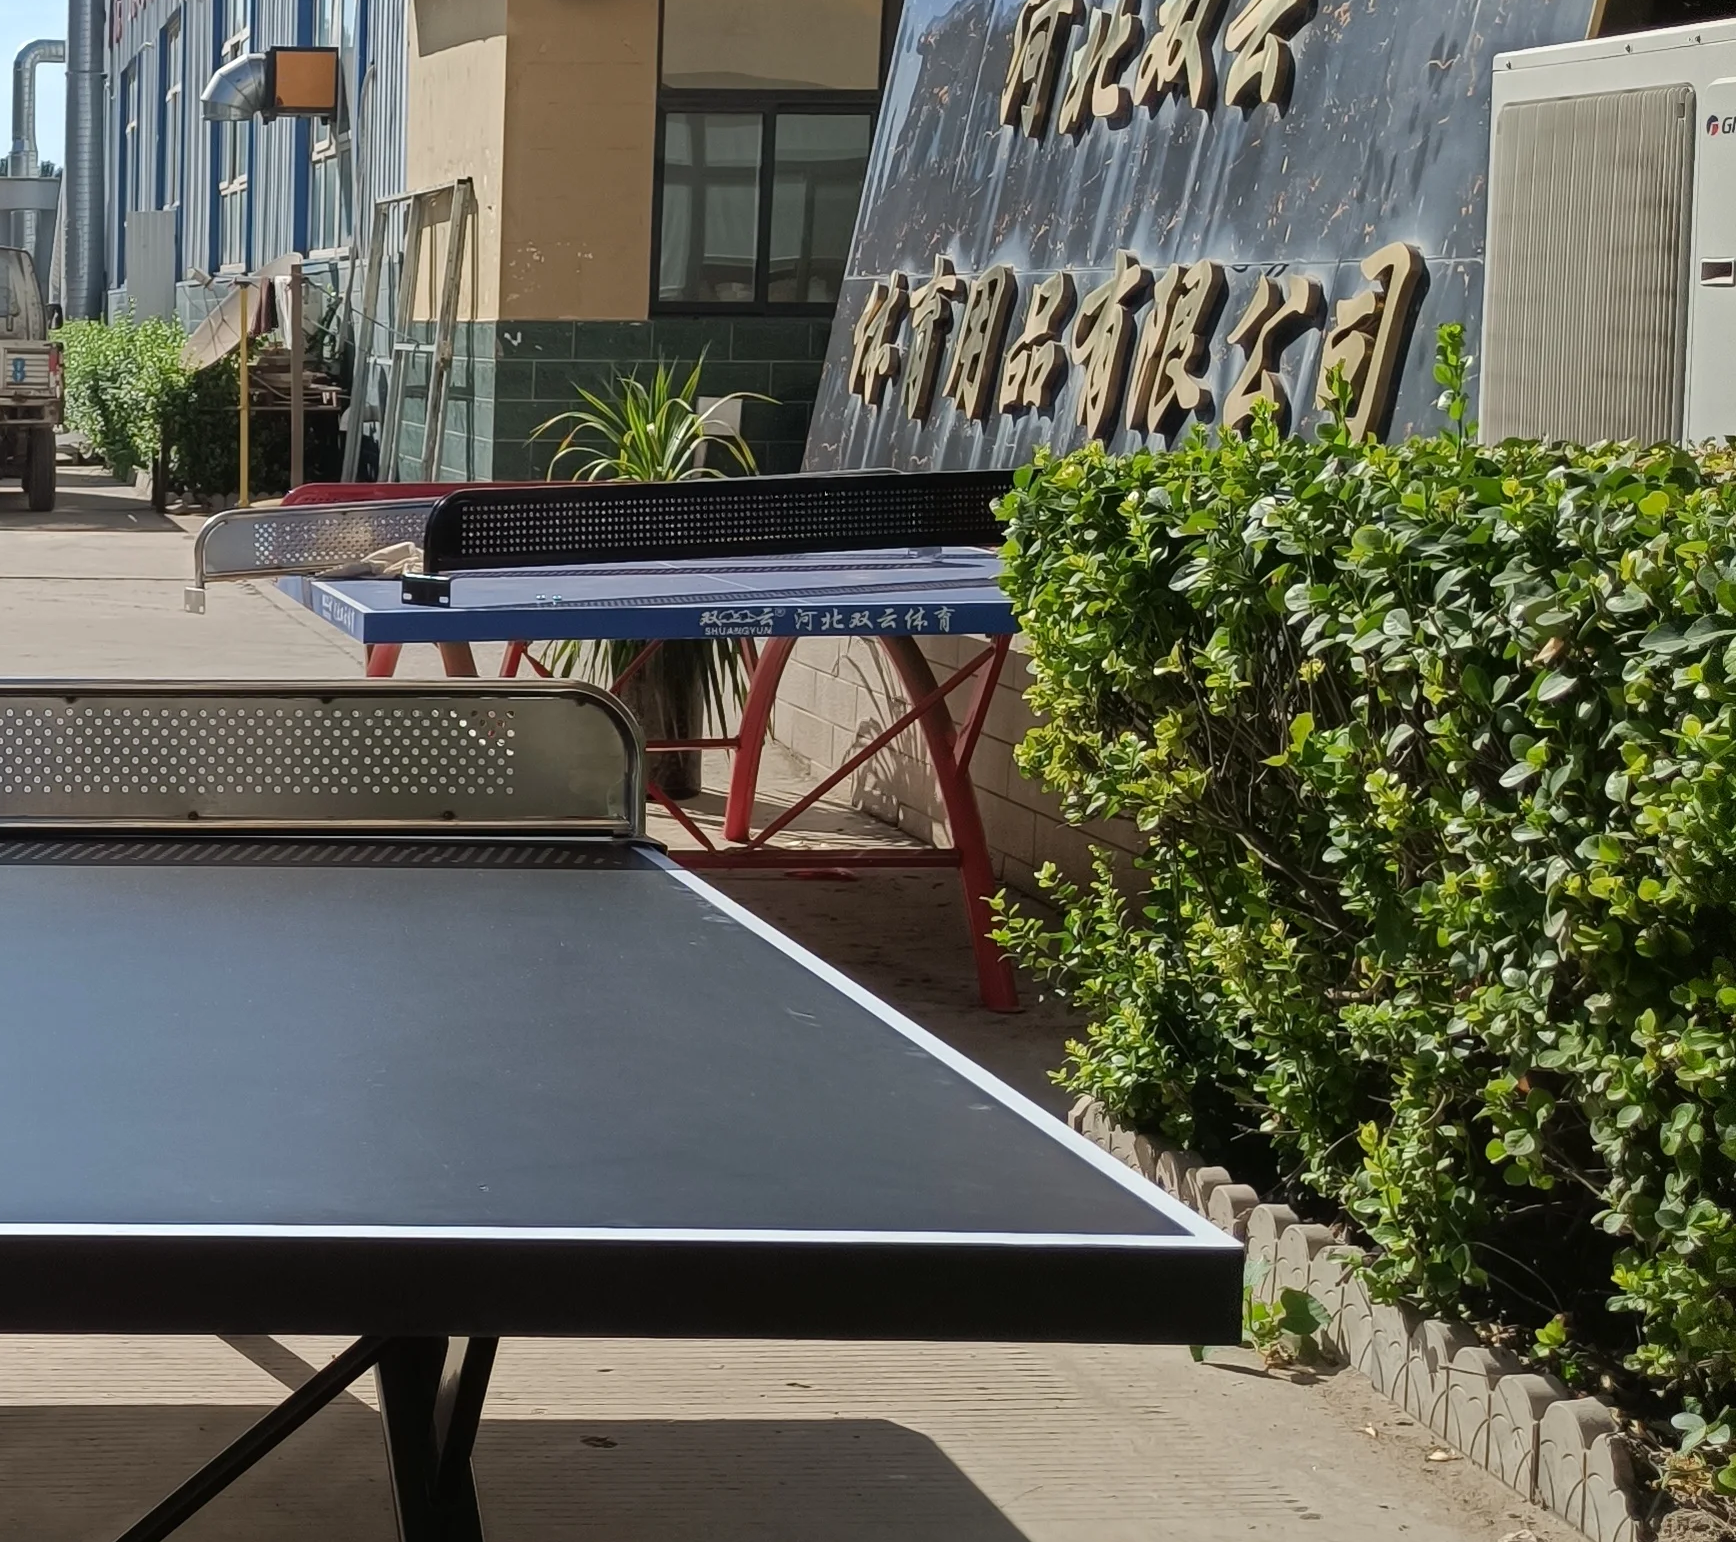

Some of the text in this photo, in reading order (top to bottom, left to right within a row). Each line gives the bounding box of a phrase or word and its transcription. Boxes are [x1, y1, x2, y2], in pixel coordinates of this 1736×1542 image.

[848, 241, 1430, 445] 体育用品有限公司
[794, 605, 956, 633] 河北双云体育
